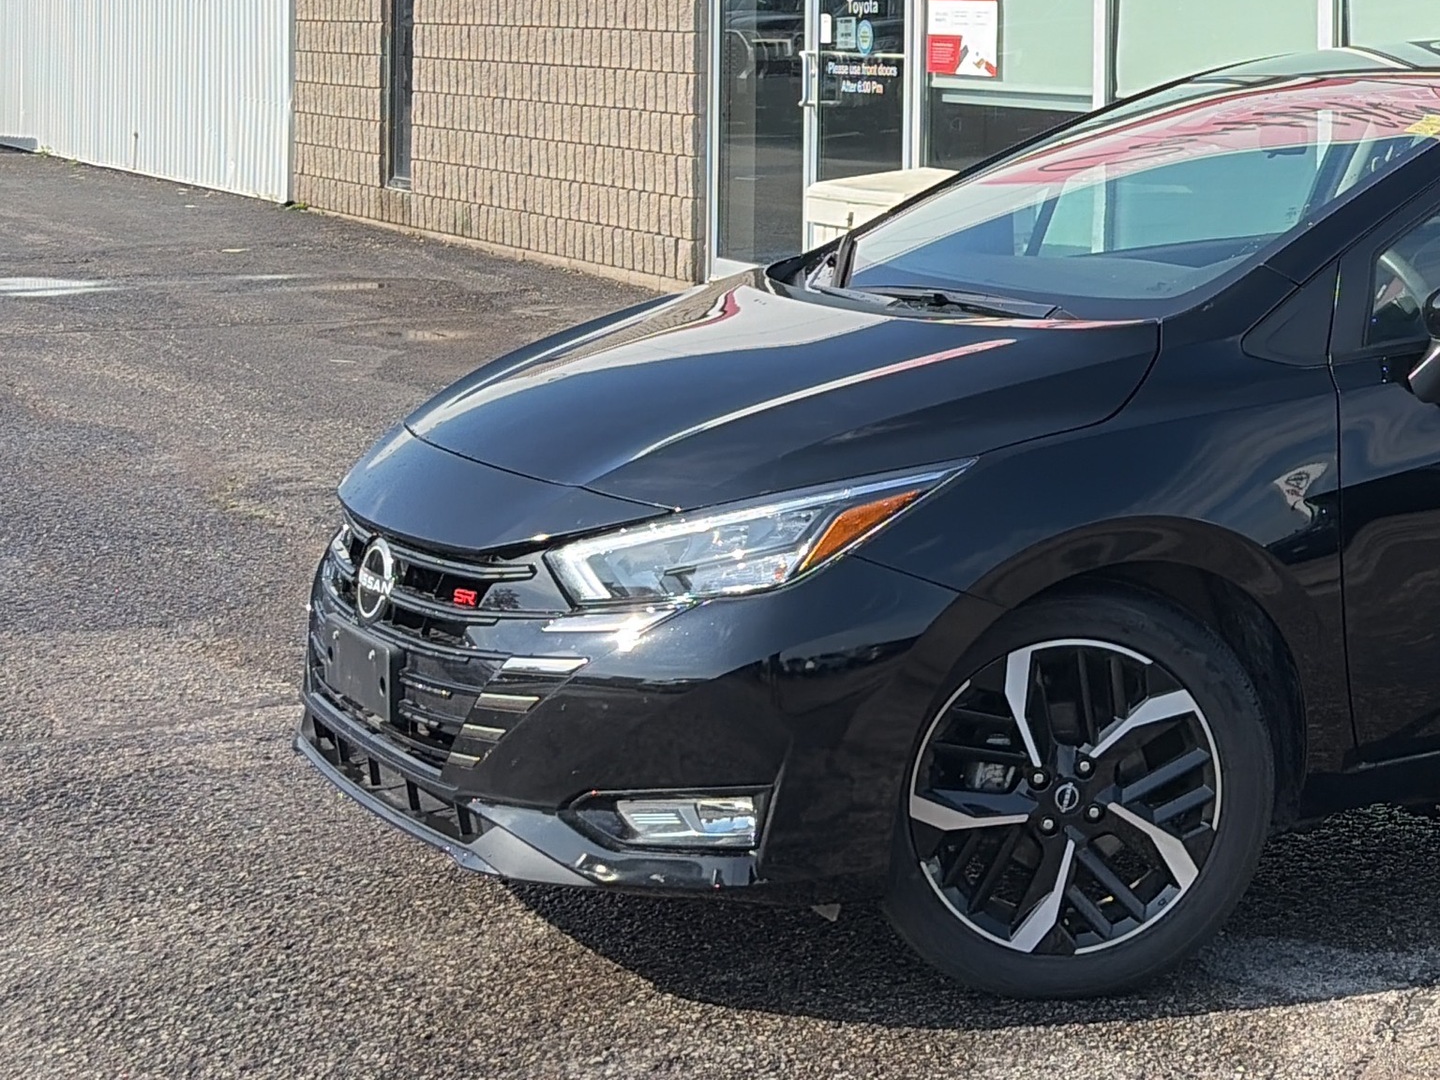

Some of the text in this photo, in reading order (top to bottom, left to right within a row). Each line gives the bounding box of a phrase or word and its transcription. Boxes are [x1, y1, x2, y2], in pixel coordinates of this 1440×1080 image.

[828, 62, 898, 77] Please use front doors
[841, 80, 857, 92] After
[857, 80, 871, 93] 6:00
[359, 568, 395, 595] SSAN
[453, 587, 478, 606] SR
